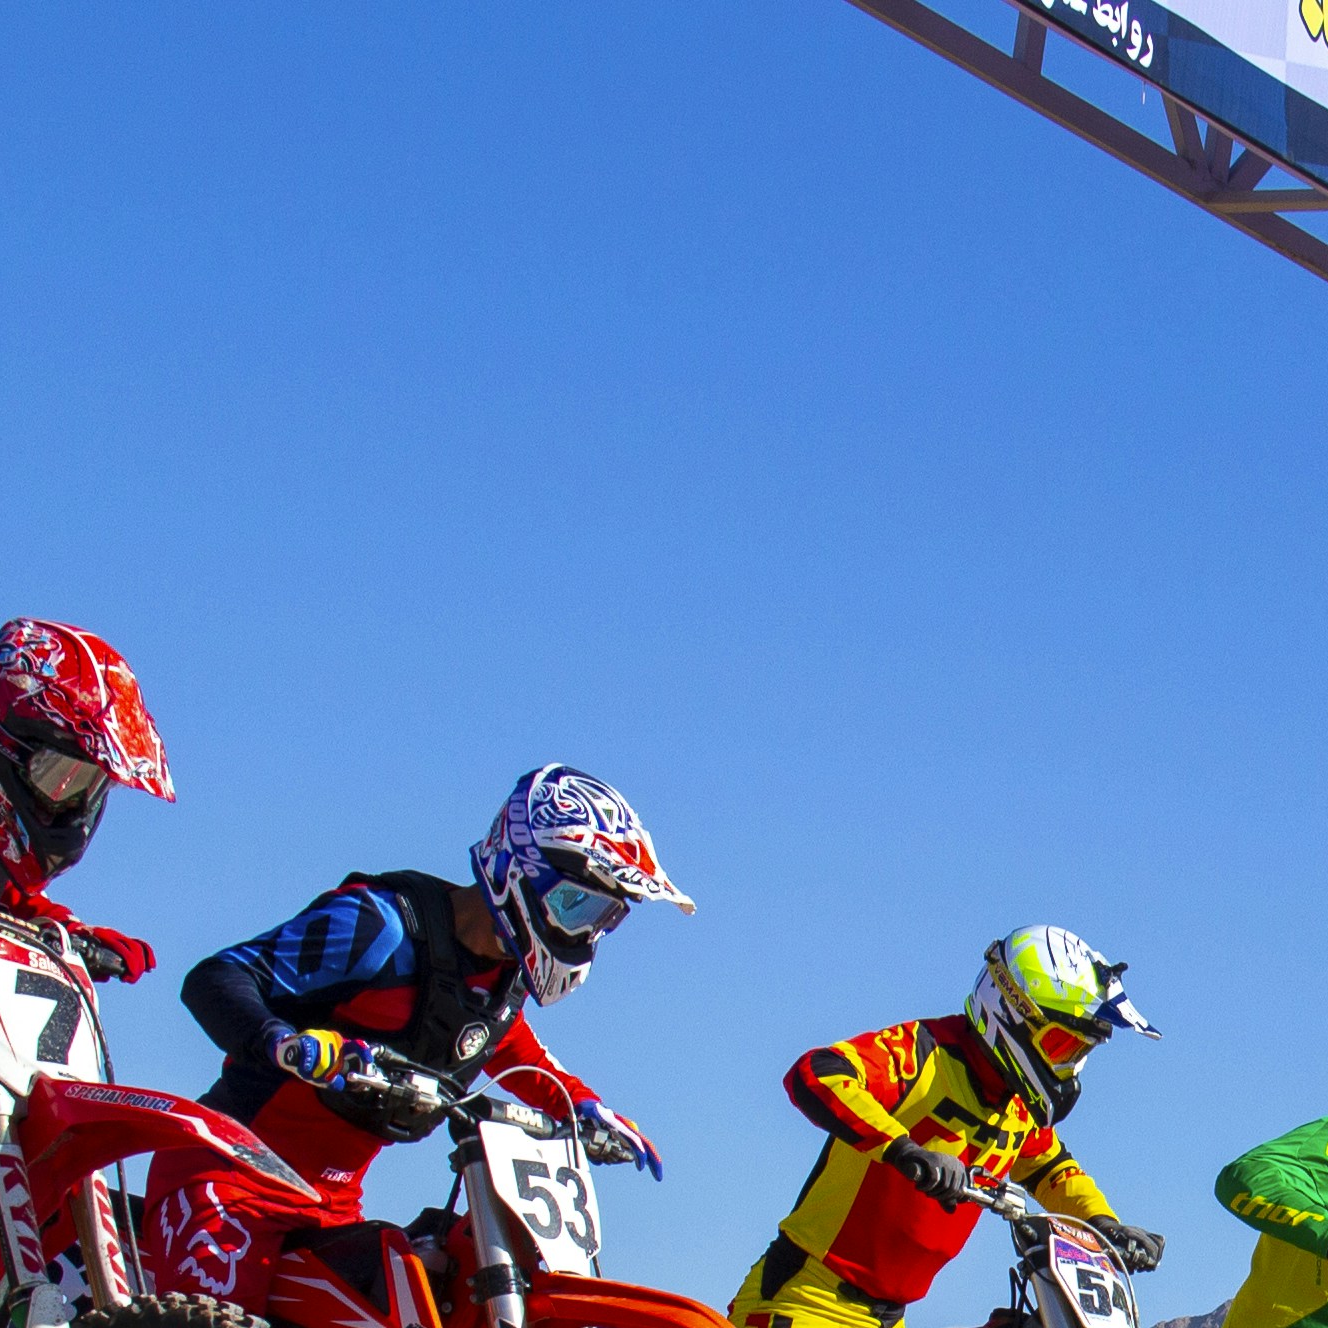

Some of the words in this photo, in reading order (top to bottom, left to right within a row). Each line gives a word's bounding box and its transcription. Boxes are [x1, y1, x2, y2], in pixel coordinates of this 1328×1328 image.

[15, 968, 82, 1066] 7
[65, 1085, 122, 1104] SPECIAL
[122, 1091, 177, 1112] POLICE
[505, 1102, 544, 1128] KTM
[512, 1158, 600, 1253] 53
[1230, 1192, 1325, 1227] thor
